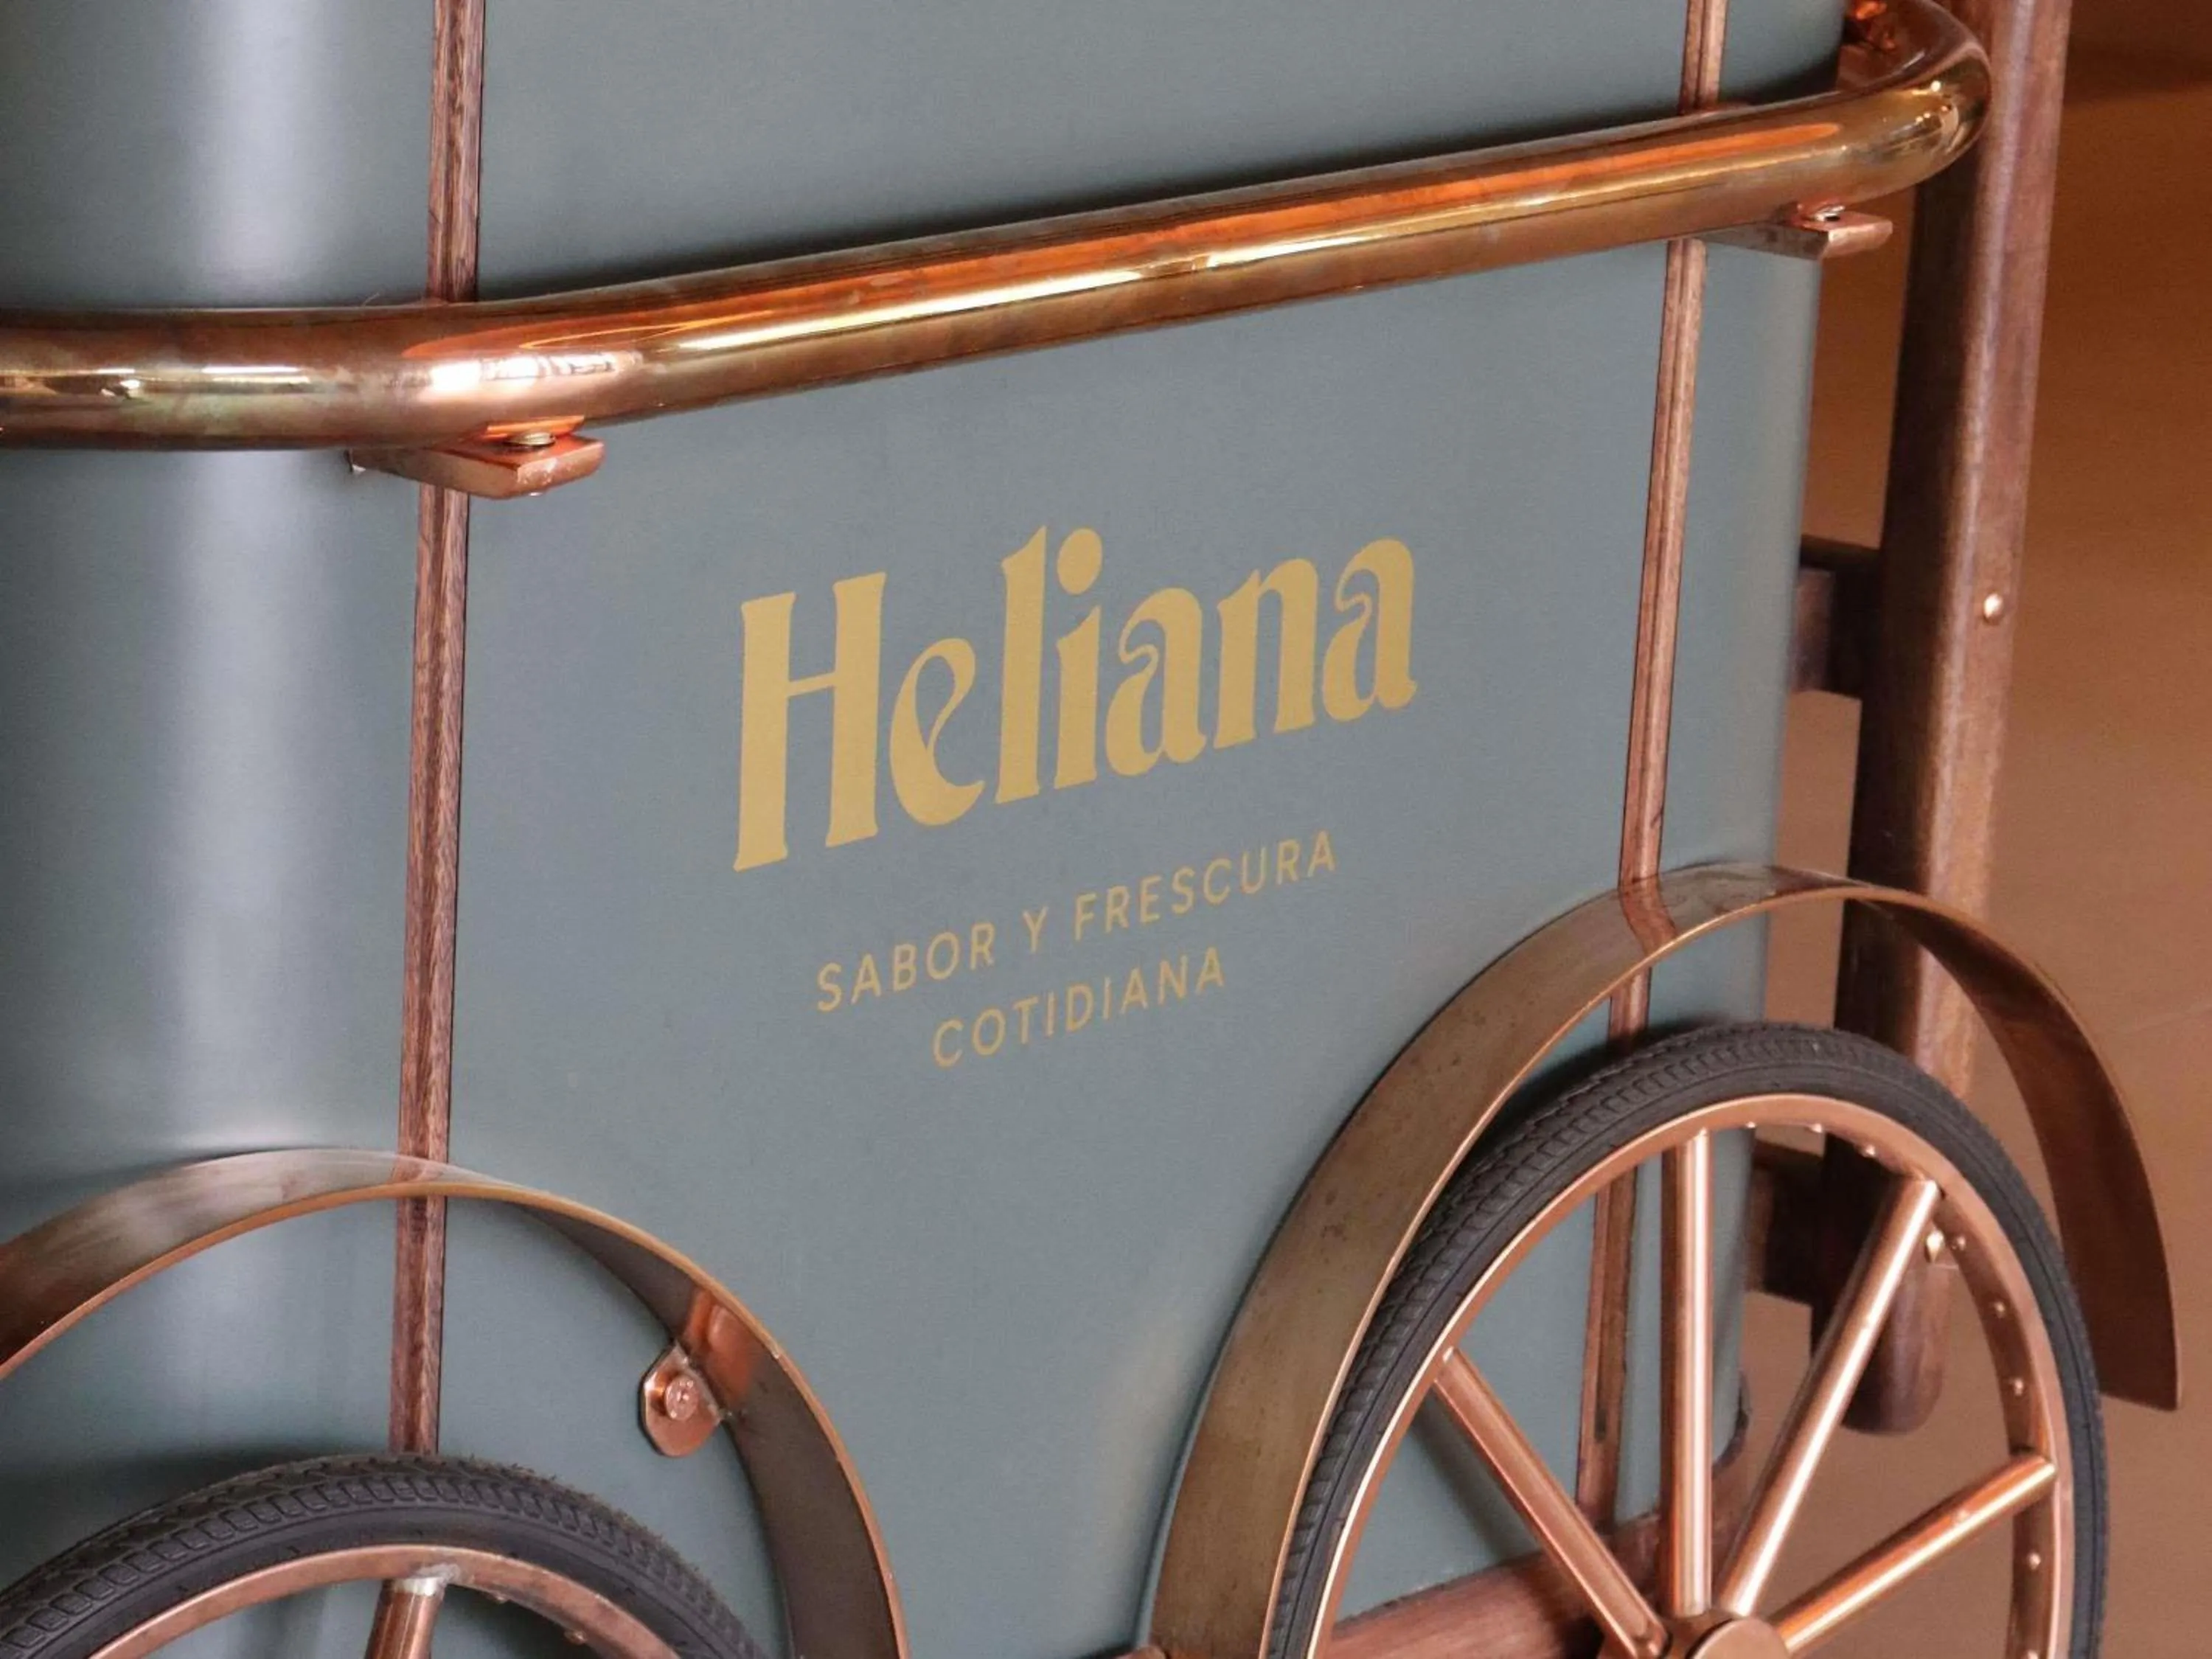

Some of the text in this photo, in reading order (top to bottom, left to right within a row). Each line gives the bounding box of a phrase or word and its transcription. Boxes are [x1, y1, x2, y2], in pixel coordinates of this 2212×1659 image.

[733, 525, 1418, 872] Heliana
[817, 831, 1336, 1013] SABOR Y FRESCURA
[933, 947, 1225, 1068] COTIDIANA
